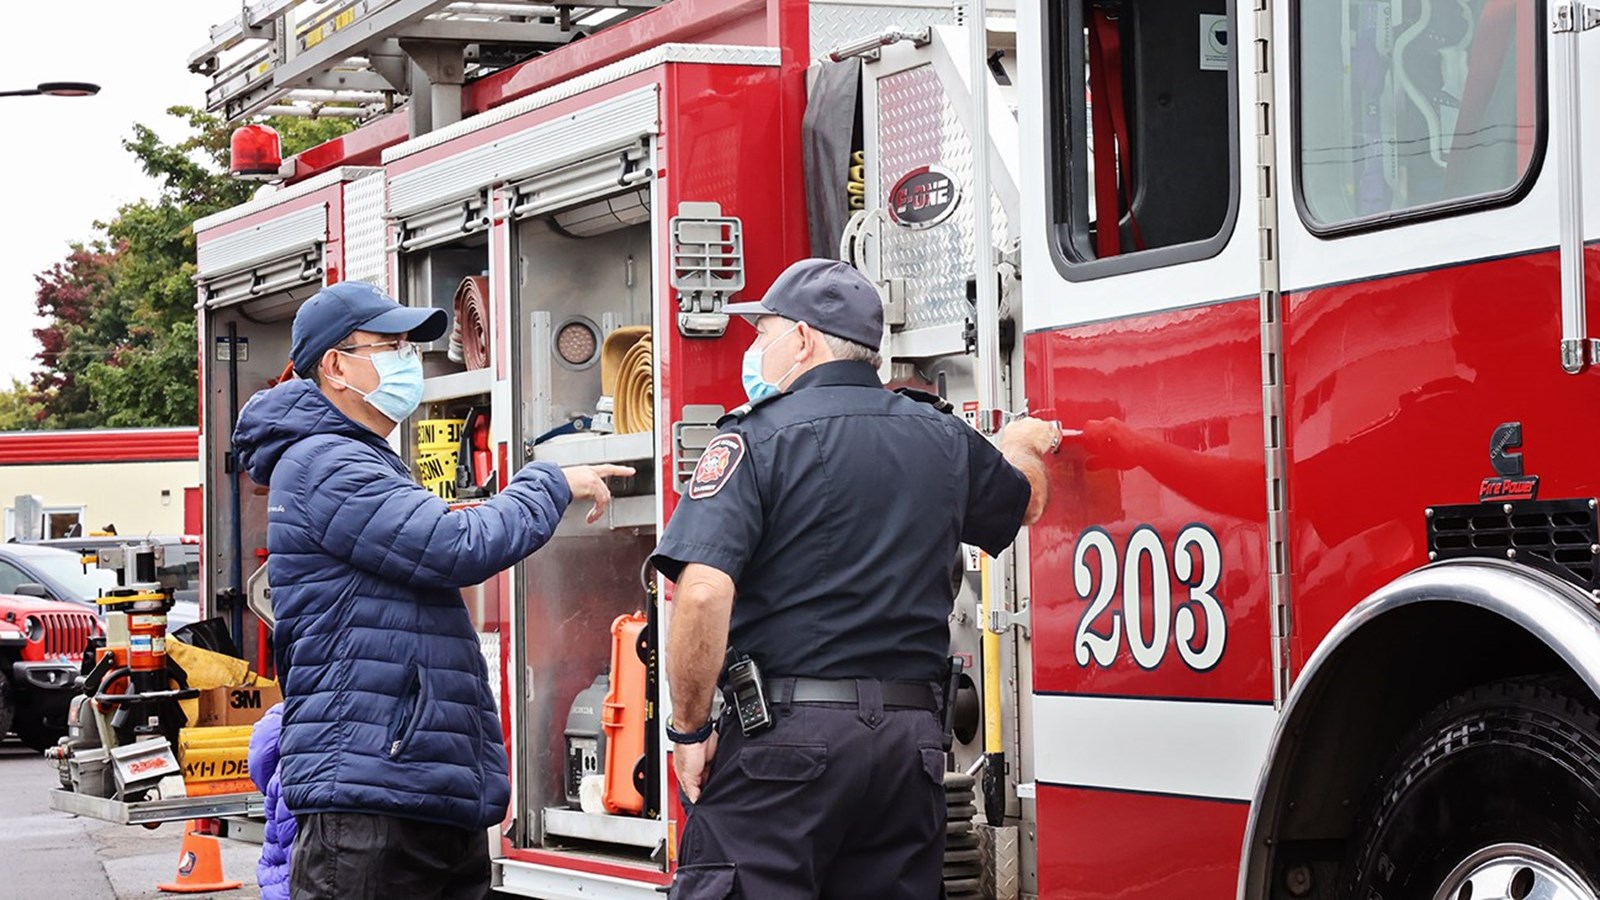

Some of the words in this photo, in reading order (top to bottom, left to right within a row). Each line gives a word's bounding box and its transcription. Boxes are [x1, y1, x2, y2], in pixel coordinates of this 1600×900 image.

[896, 178, 949, 214] E-ONE
[1480, 480, 1501, 495] Fire
[1502, 479, 1535, 494] Power
[1073, 522, 1228, 673] 203
[229, 690, 261, 709] 3M
